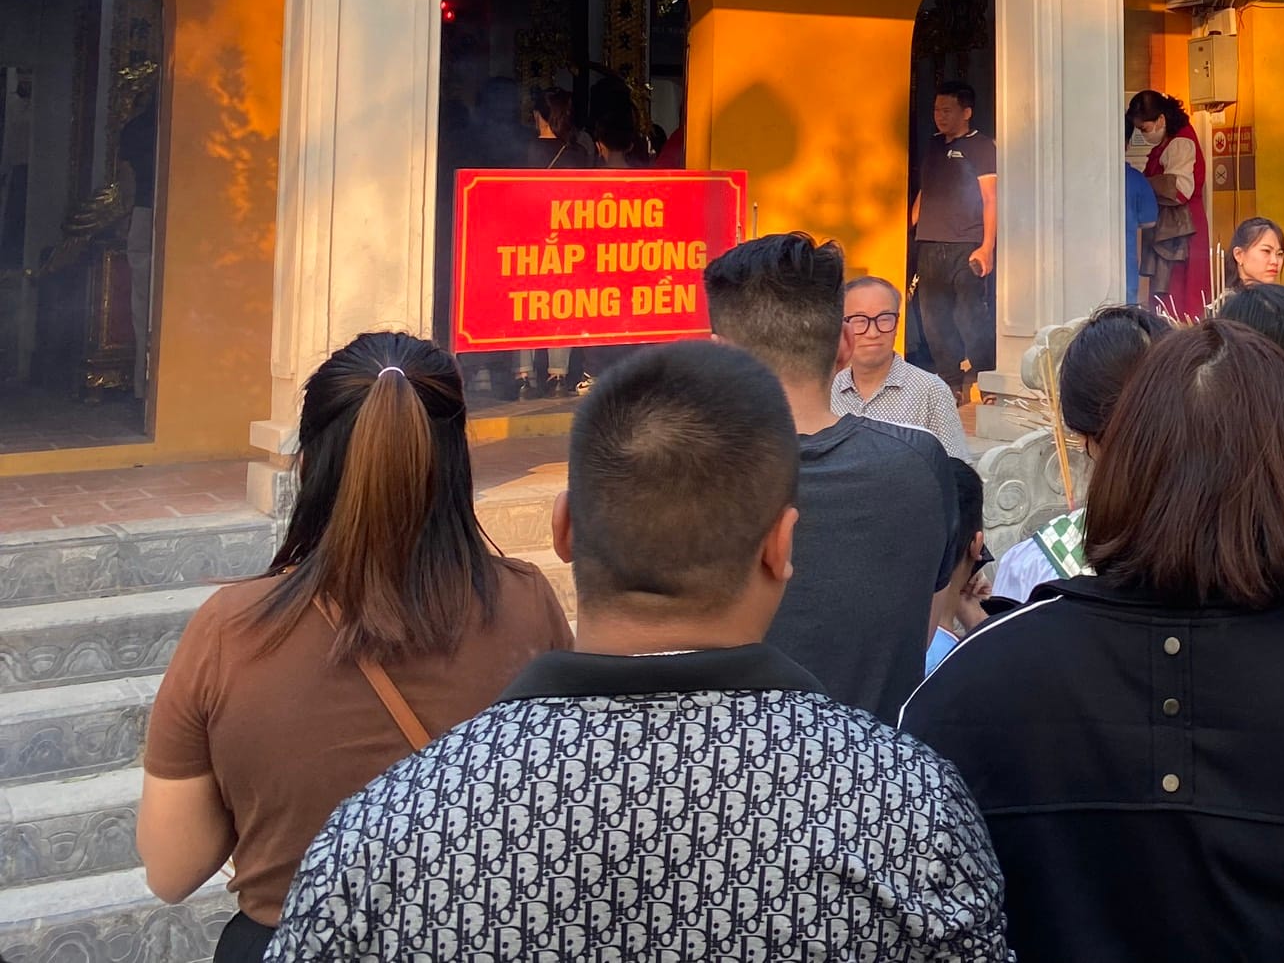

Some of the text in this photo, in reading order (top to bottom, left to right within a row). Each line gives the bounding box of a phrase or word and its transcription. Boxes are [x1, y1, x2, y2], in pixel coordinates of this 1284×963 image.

[551, 192, 664, 229] KHÔNG
[497, 232, 707, 276] THẮP HƯƠNG
[509, 275, 697, 321] TRONG ĐỀN
